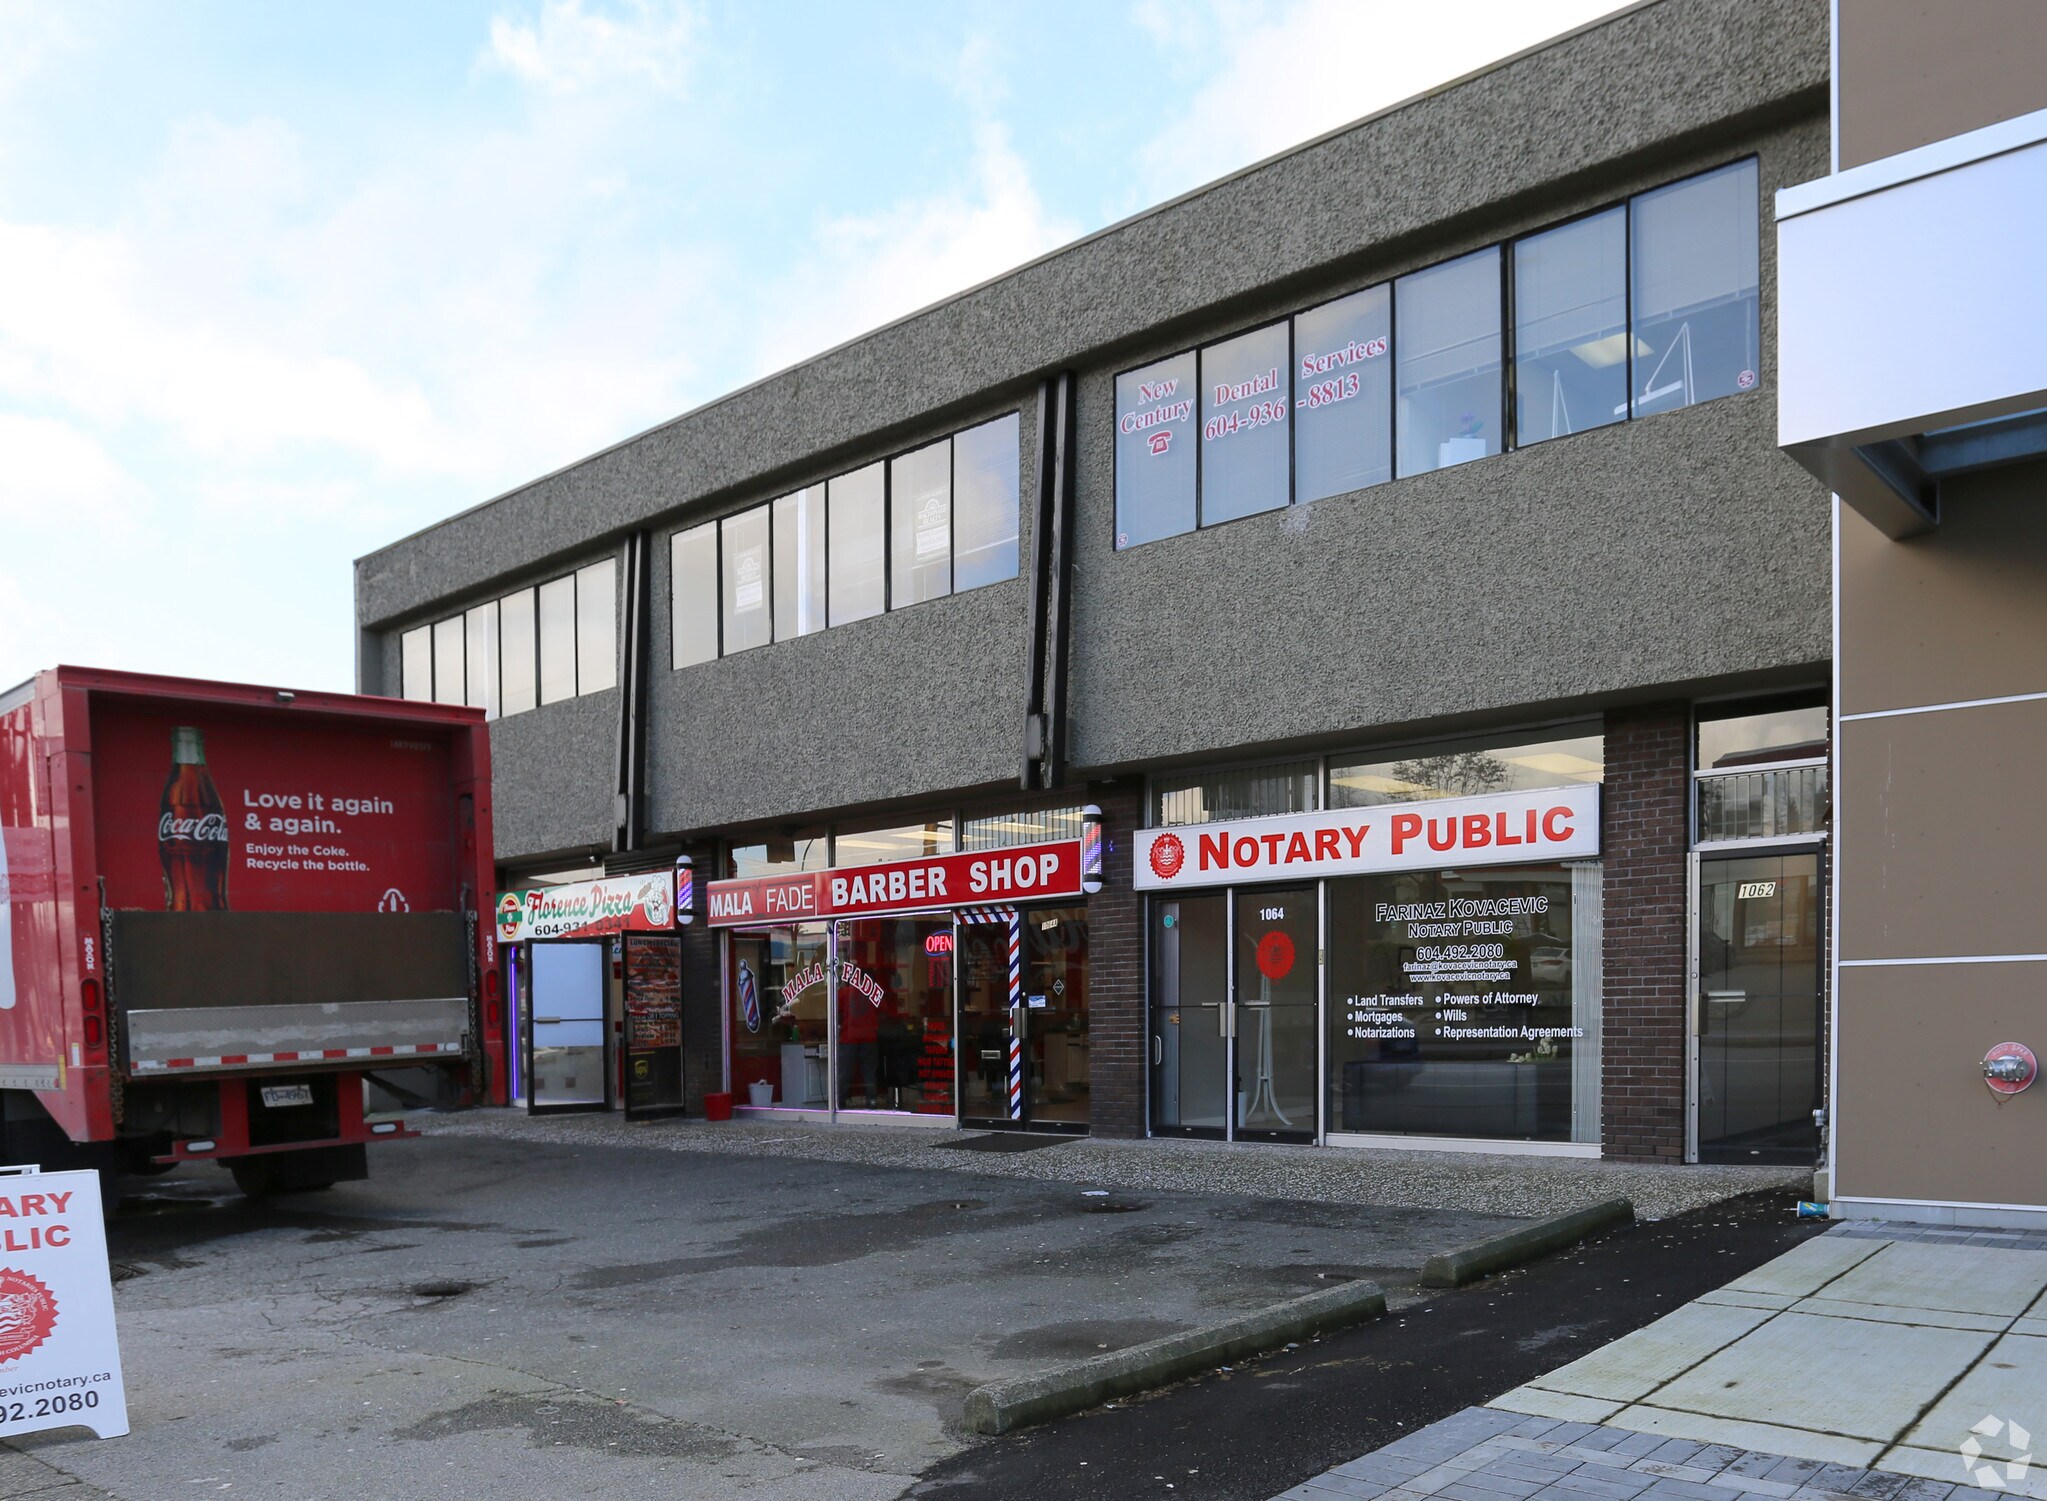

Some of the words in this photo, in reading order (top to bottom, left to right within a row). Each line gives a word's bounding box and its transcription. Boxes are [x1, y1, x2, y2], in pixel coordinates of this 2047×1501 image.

[1302, 336, 1387, 379] Services
[1138, 378, 1178, 405] New
[1214, 367, 1278, 407] Dental
[1120, 399, 1194, 434] Century
[1204, 396, 1286, 441] 604-936
[244, 789, 302, 809] Love
[308, 793, 324, 811] it
[331, 797, 394, 816] again
[244, 813, 262, 831] &
[269, 816, 342, 836] again.
[1199, 825, 1370, 871] NOTARY
[1391, 806, 1575, 855] PUBLIC
[245, 843, 283, 856] Enjoy
[288, 845, 309, 856] the
[312, 845, 349, 857] Coke.
[246, 858, 299, 871] Recycle
[302, 860, 324, 871] the
[328, 860, 370, 872] bottle.
[831, 866, 948, 907] BARBER
[969, 853, 1060, 893] SHOP
[1742, 883, 1774, 897] 1062
[527, 889, 588, 926] Florence
[589, 883, 634, 917] Pizza
[709, 891, 753, 918] MALA
[766, 884, 814, 913] FADE
[1376, 902, 1446, 922] FARINAZ
[1449, 896, 1548, 918] KOVACEVIC
[1260, 907, 1284, 920] 1064
[1408, 922, 1461, 938] NOTARY
[1463, 920, 1513, 936] PUBLIC
[926, 935, 954, 952] OPEN
[1416, 944, 1503, 961] 604.492.2080
[84, 937, 95, 970] MAXON
[1403, 960, 1517, 973] farinaz@kovacevicnotary.ca
[781, 962, 825, 1005] MALA
[841, 961, 885, 1008] FADE
[1410, 971, 1510, 982] www.kovacevicnotary.ca
[1355, 994, 1377, 1006] Land
[1379, 993, 1424, 1006] Transfers
[1443, 992, 1480, 1005] Powers
[1482, 992, 1493, 1004] of
[1494, 992, 1539, 1006] Attorney
[1355, 1010, 1403, 1025] Mortgages
[1443, 1009, 1467, 1021] Wills
[1355, 1026, 1415, 1038] Notarizations
[1443, 1025, 1518, 1040] Representation
[1520, 1025, 1584, 1041] Agreements
